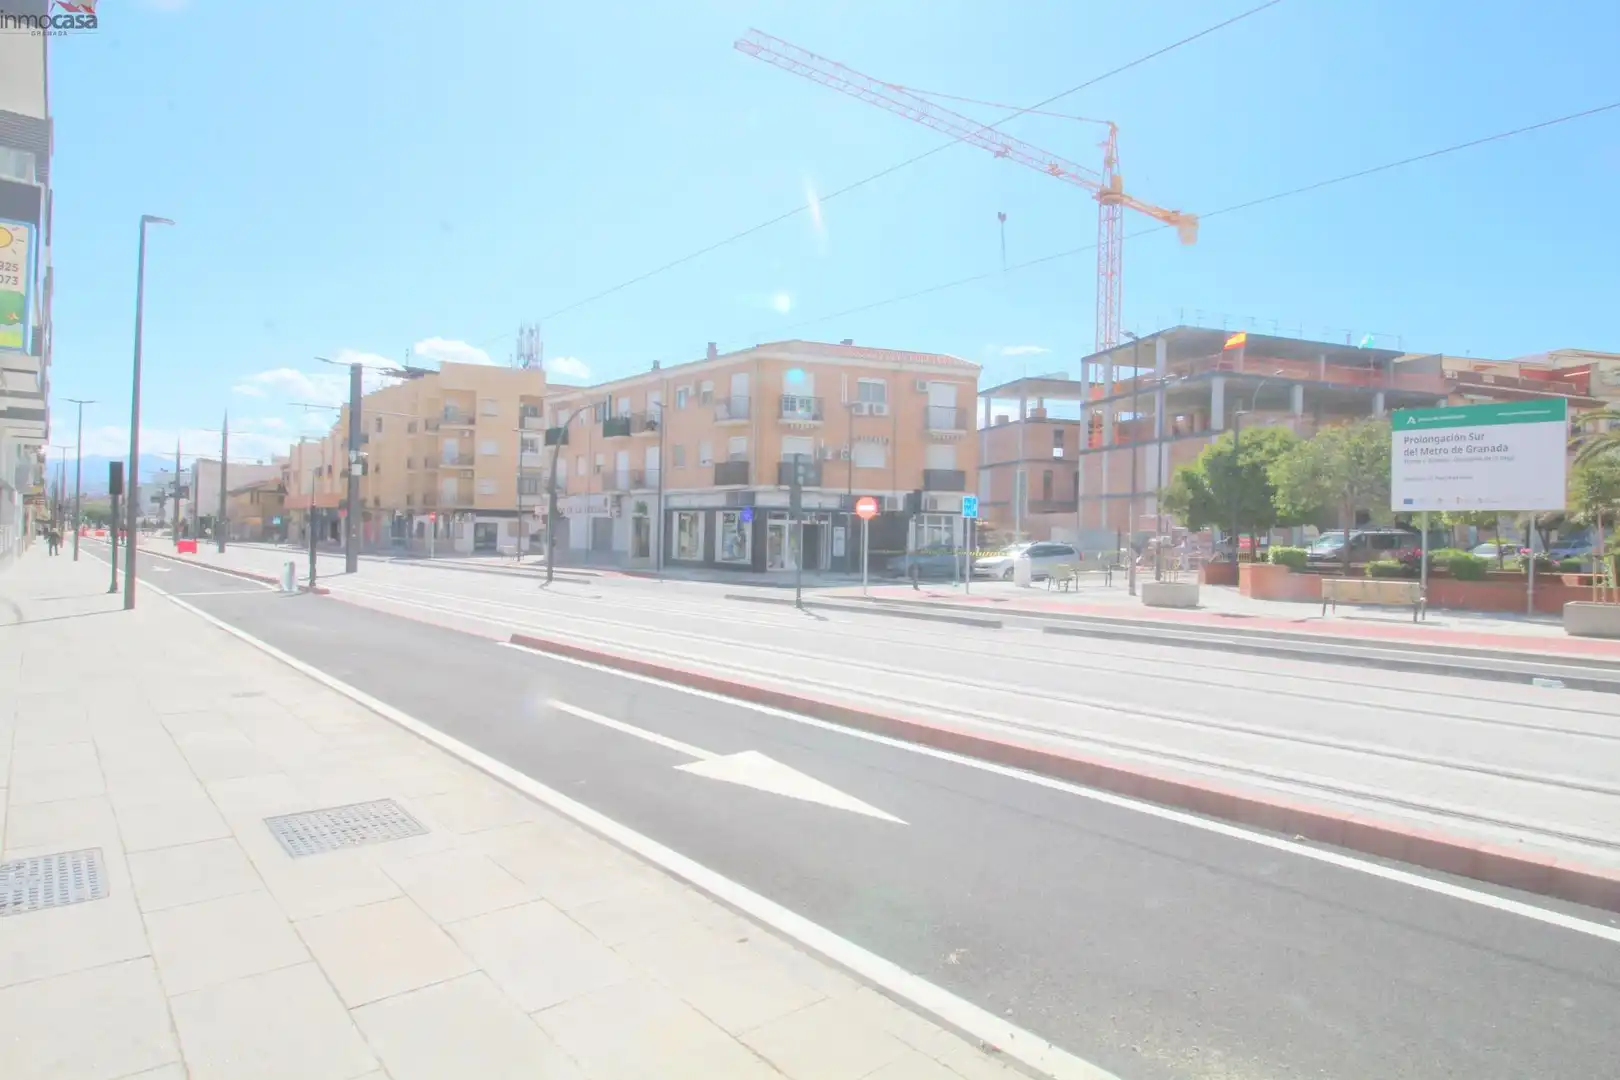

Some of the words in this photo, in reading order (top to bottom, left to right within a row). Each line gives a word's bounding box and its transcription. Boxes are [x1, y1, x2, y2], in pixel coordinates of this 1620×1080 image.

[1404, 432, 1466, 445] Prolongación
[1468, 431, 1486, 441] Sur
[1403, 447, 1418, 456] del
[1420, 446, 1449, 456] Metro
[1451, 445, 1463, 454] de
[1465, 443, 1509, 453] Granada
